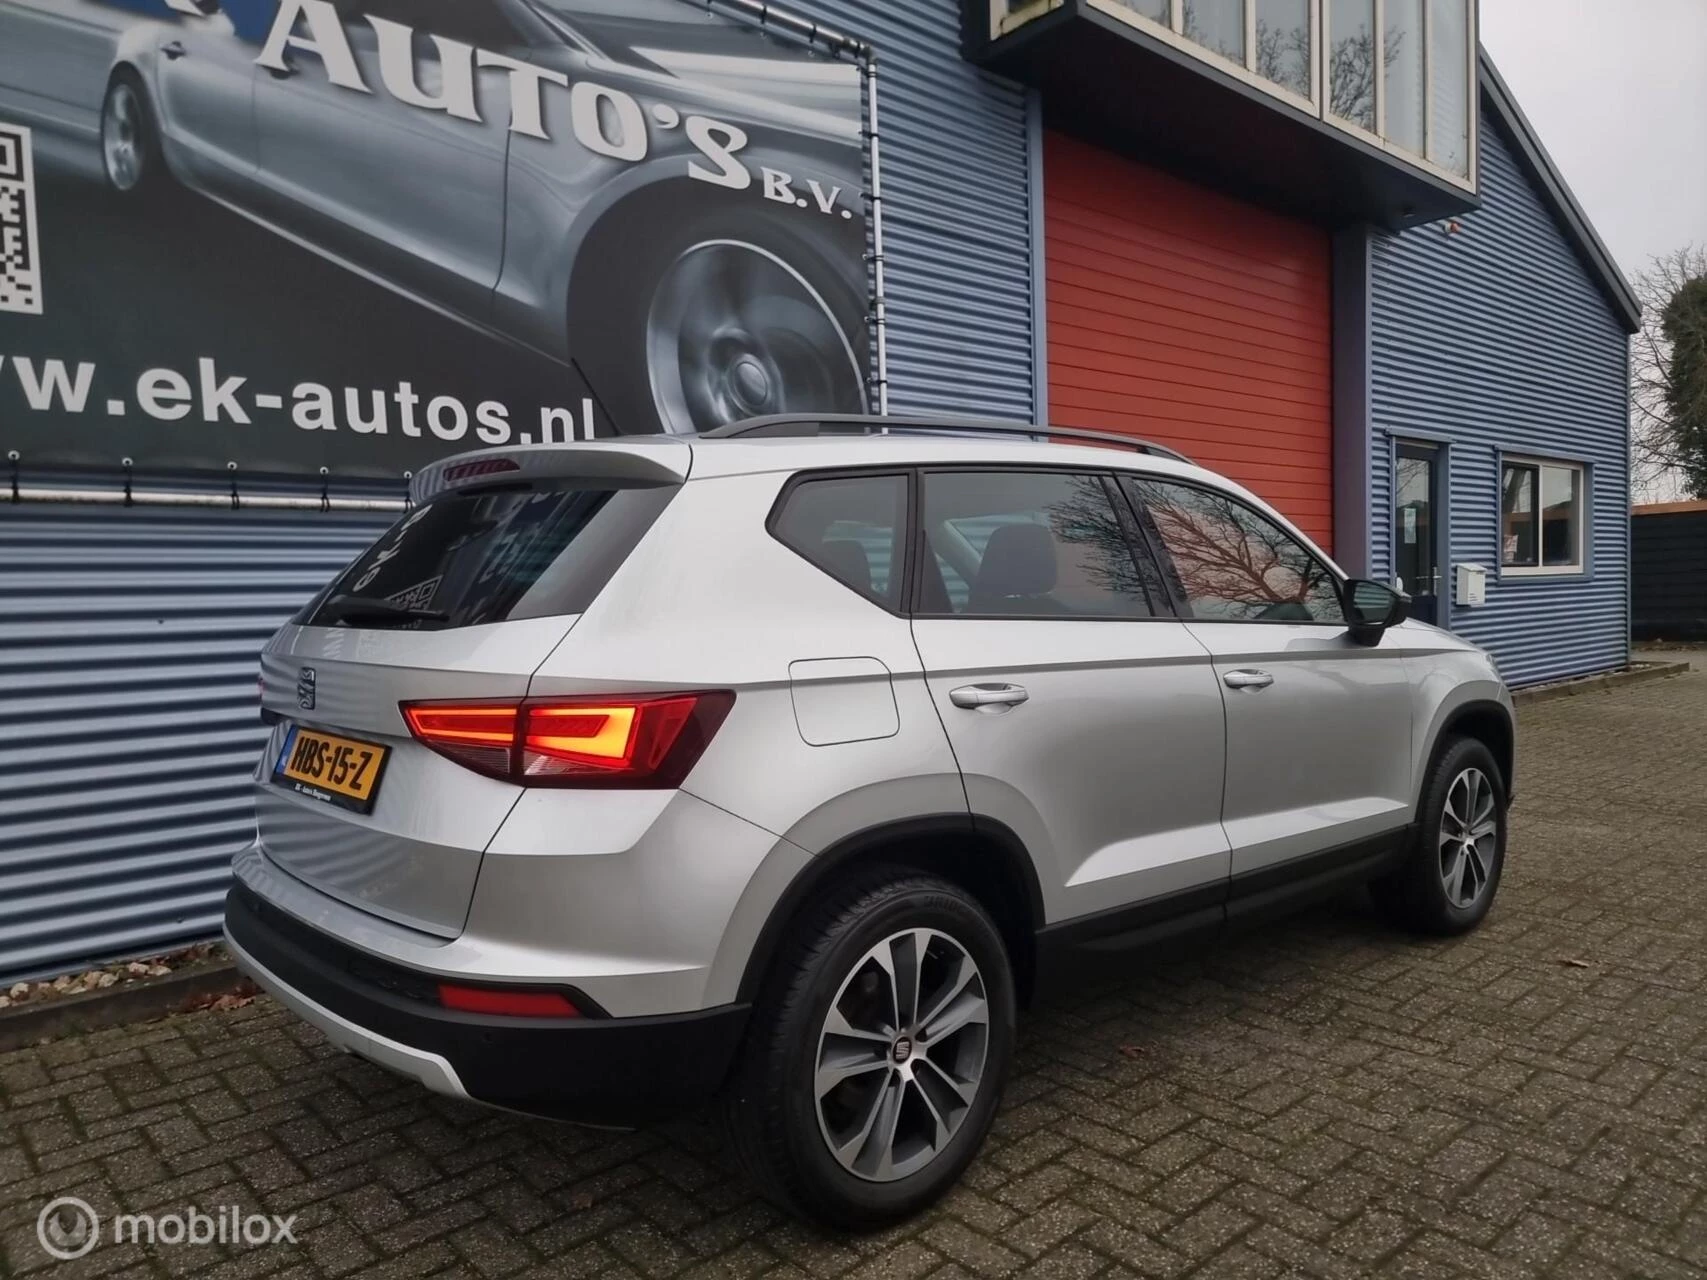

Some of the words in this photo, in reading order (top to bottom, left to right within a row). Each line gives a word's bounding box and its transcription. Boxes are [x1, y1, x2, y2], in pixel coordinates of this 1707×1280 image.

[760, 166, 852, 219] B.V.
[0, 354, 595, 445] w.ek-autos.nl
[290, 736, 374, 791] HBS-15-Z
